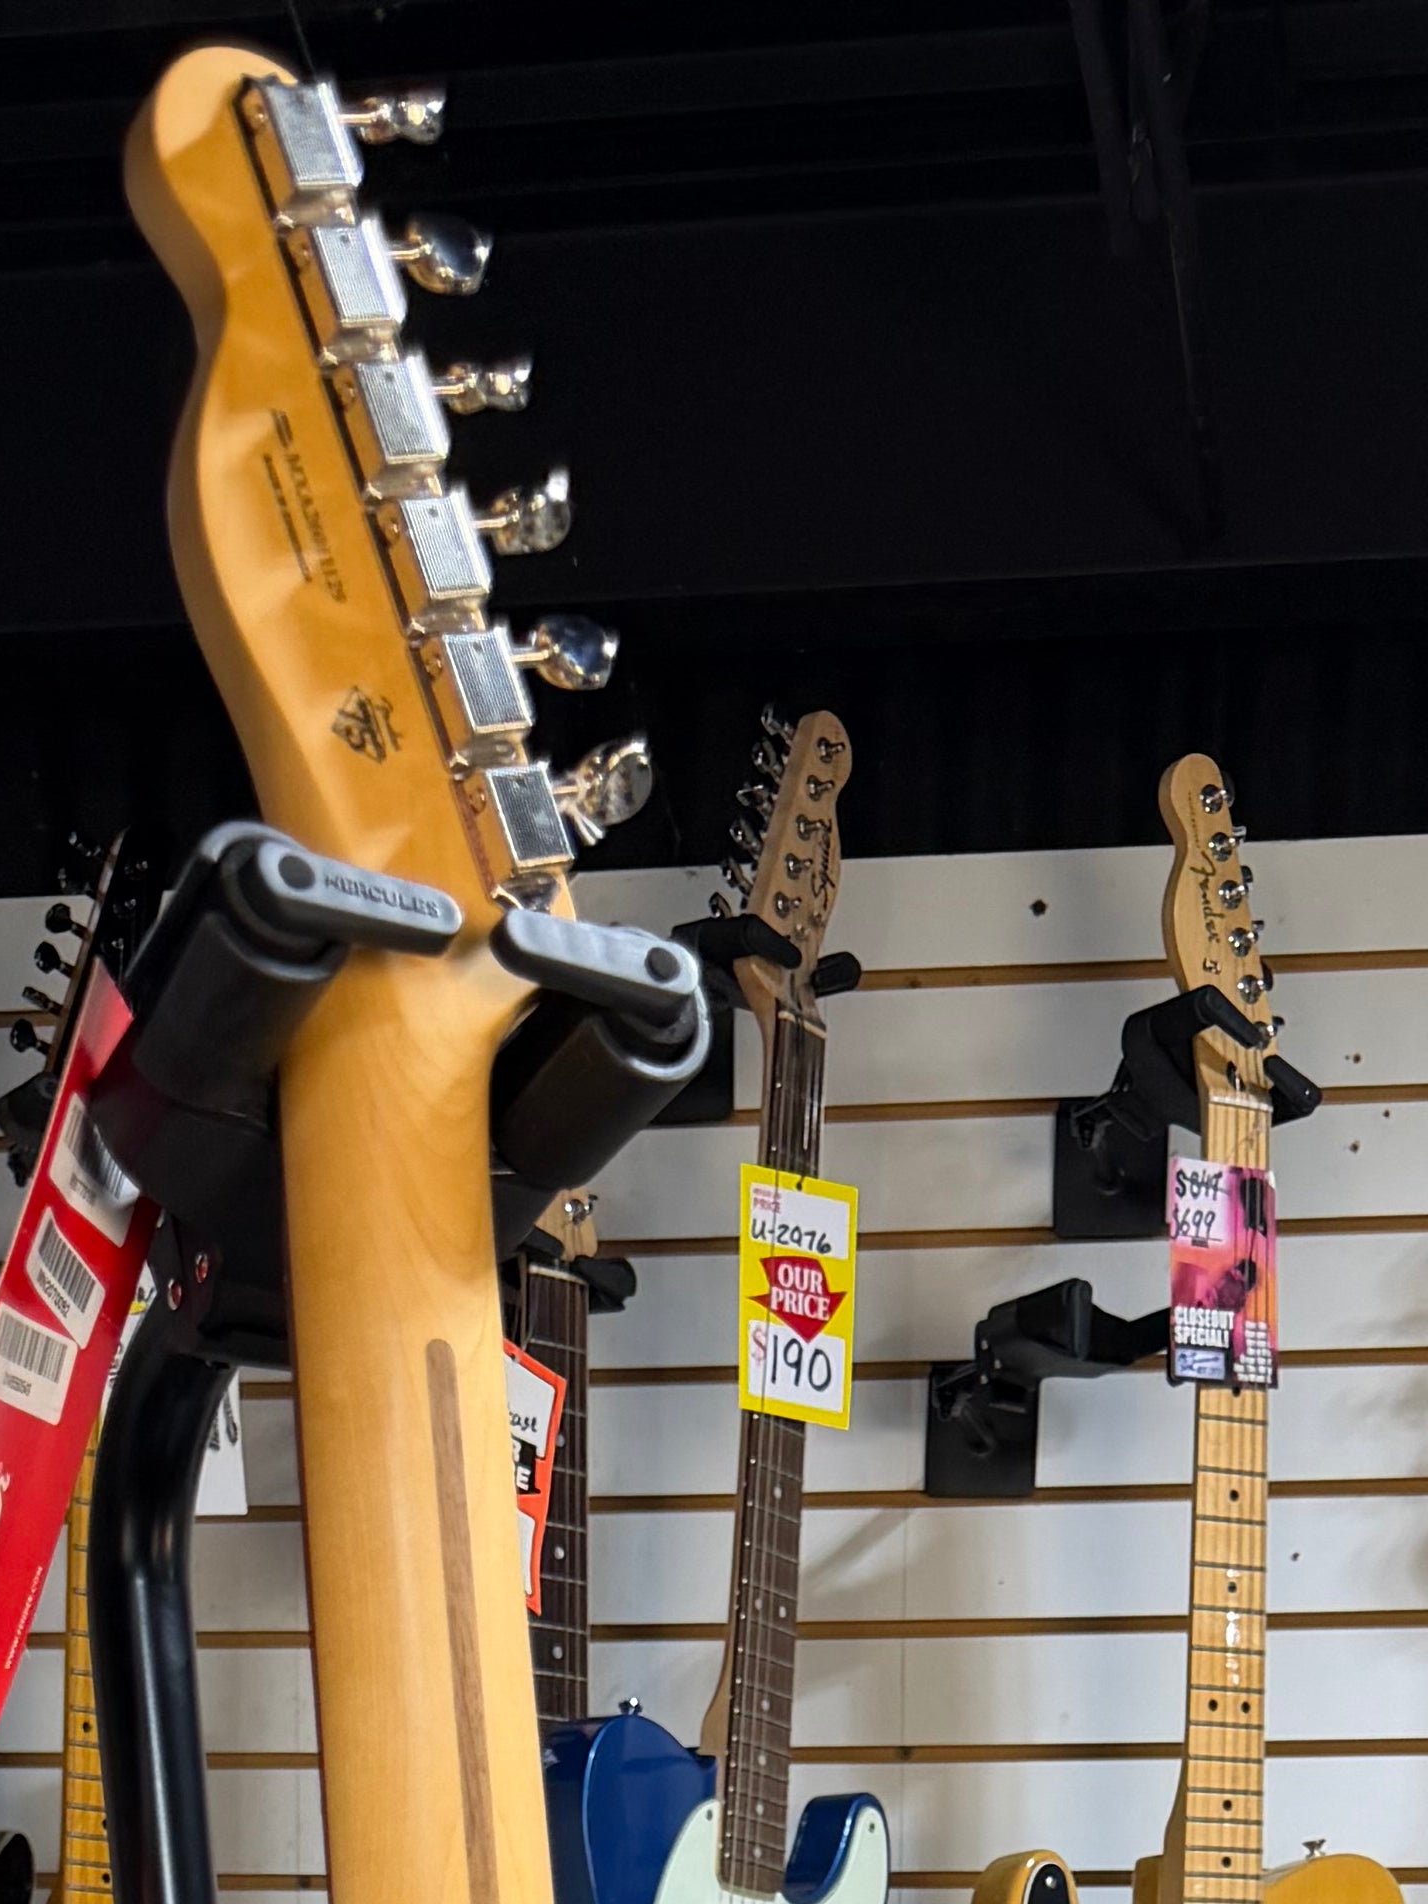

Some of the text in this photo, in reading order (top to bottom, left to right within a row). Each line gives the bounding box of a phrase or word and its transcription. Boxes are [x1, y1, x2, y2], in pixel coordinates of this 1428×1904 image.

[324, 875, 439, 918] HERCULES
[1189, 849, 1225, 943] Fender
[1171, 1203, 1217, 1241] $699
[777, 1264, 824, 1295] OUR
[771, 1287, 832, 1321] PRICE
